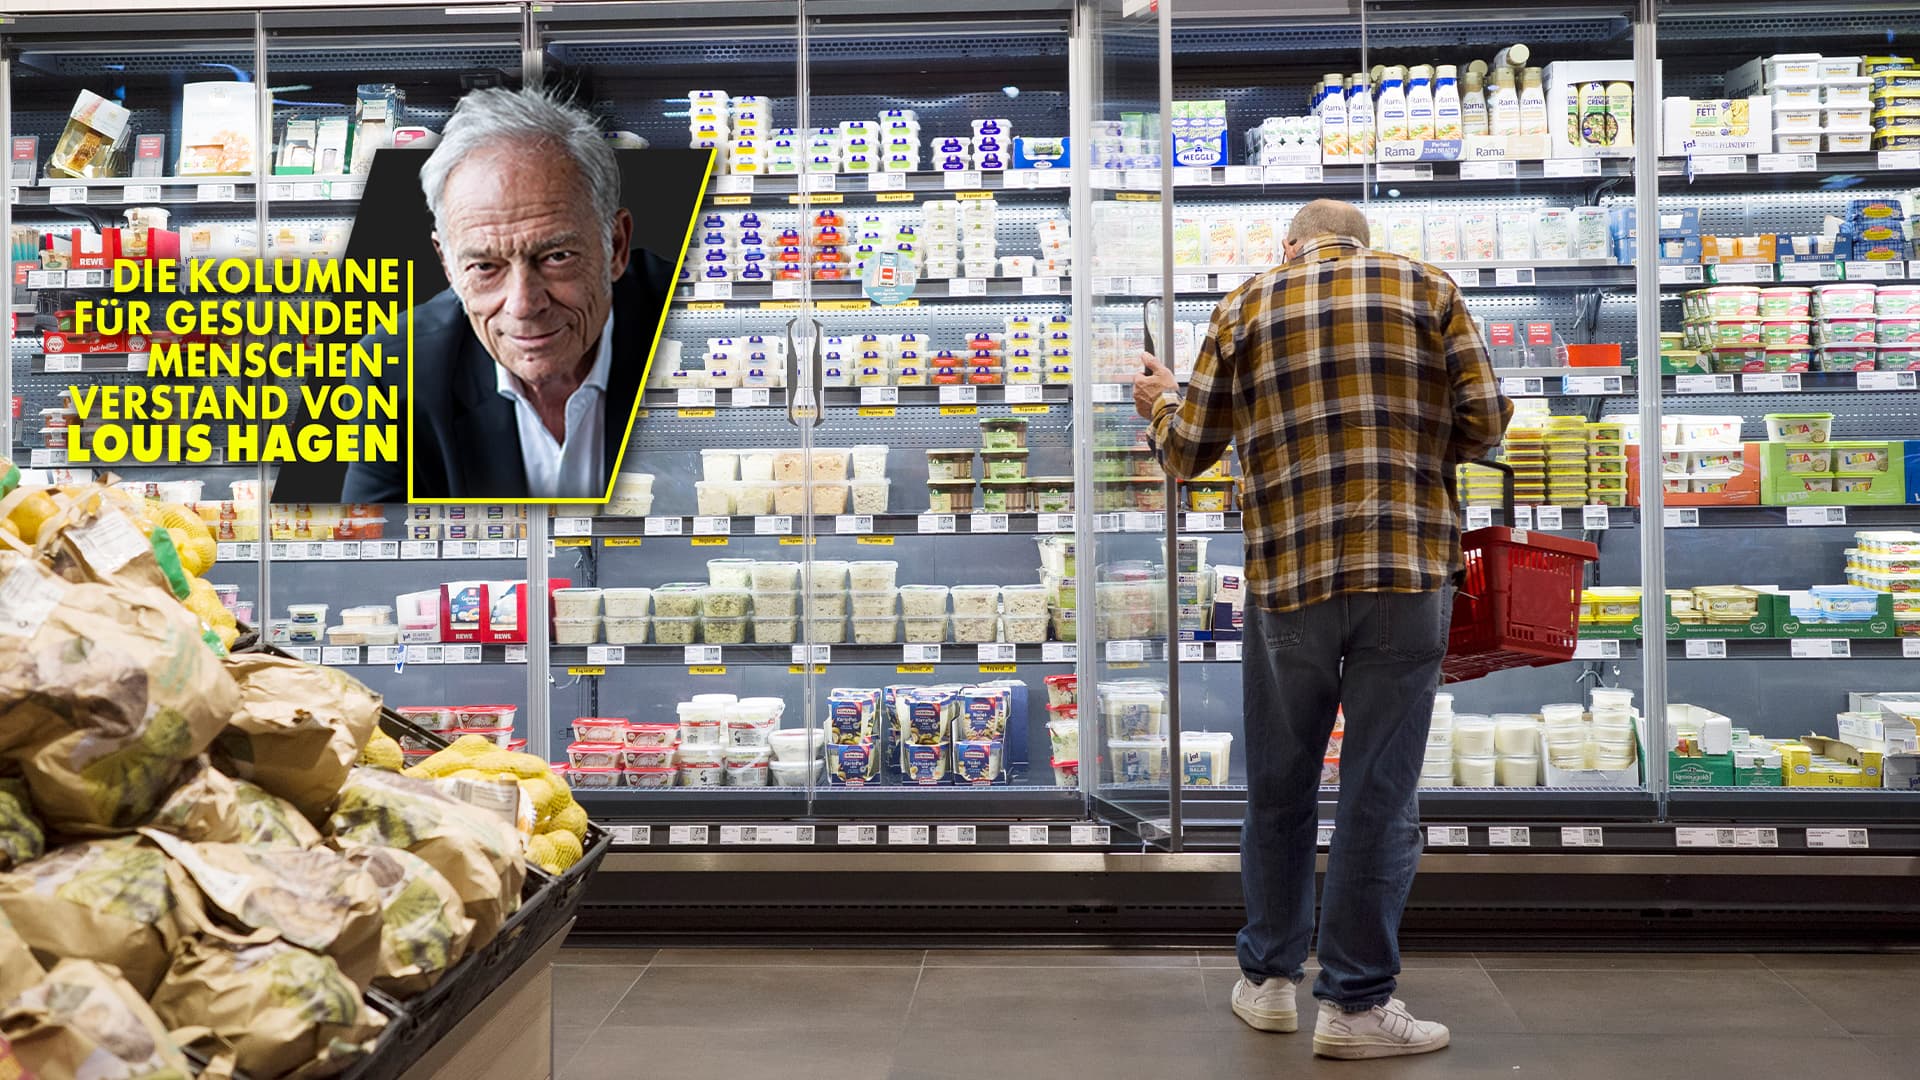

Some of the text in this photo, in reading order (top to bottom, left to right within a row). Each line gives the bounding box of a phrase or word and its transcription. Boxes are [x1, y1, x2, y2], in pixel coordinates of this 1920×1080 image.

[1682, 139, 1697, 152] ja!
[1183, 153, 1214, 161] MEGGLE
[1384, 146, 1416, 157] Rama
[1476, 147, 1505, 157] Rama
[79, 258, 104, 266] REWE
[1779, 424, 1810, 436] LÄTTA
[1700, 455, 1730, 468] LÄTTA
[1845, 452, 1876, 465] LÄTTA
[1828, 775, 1835, 784] 5
